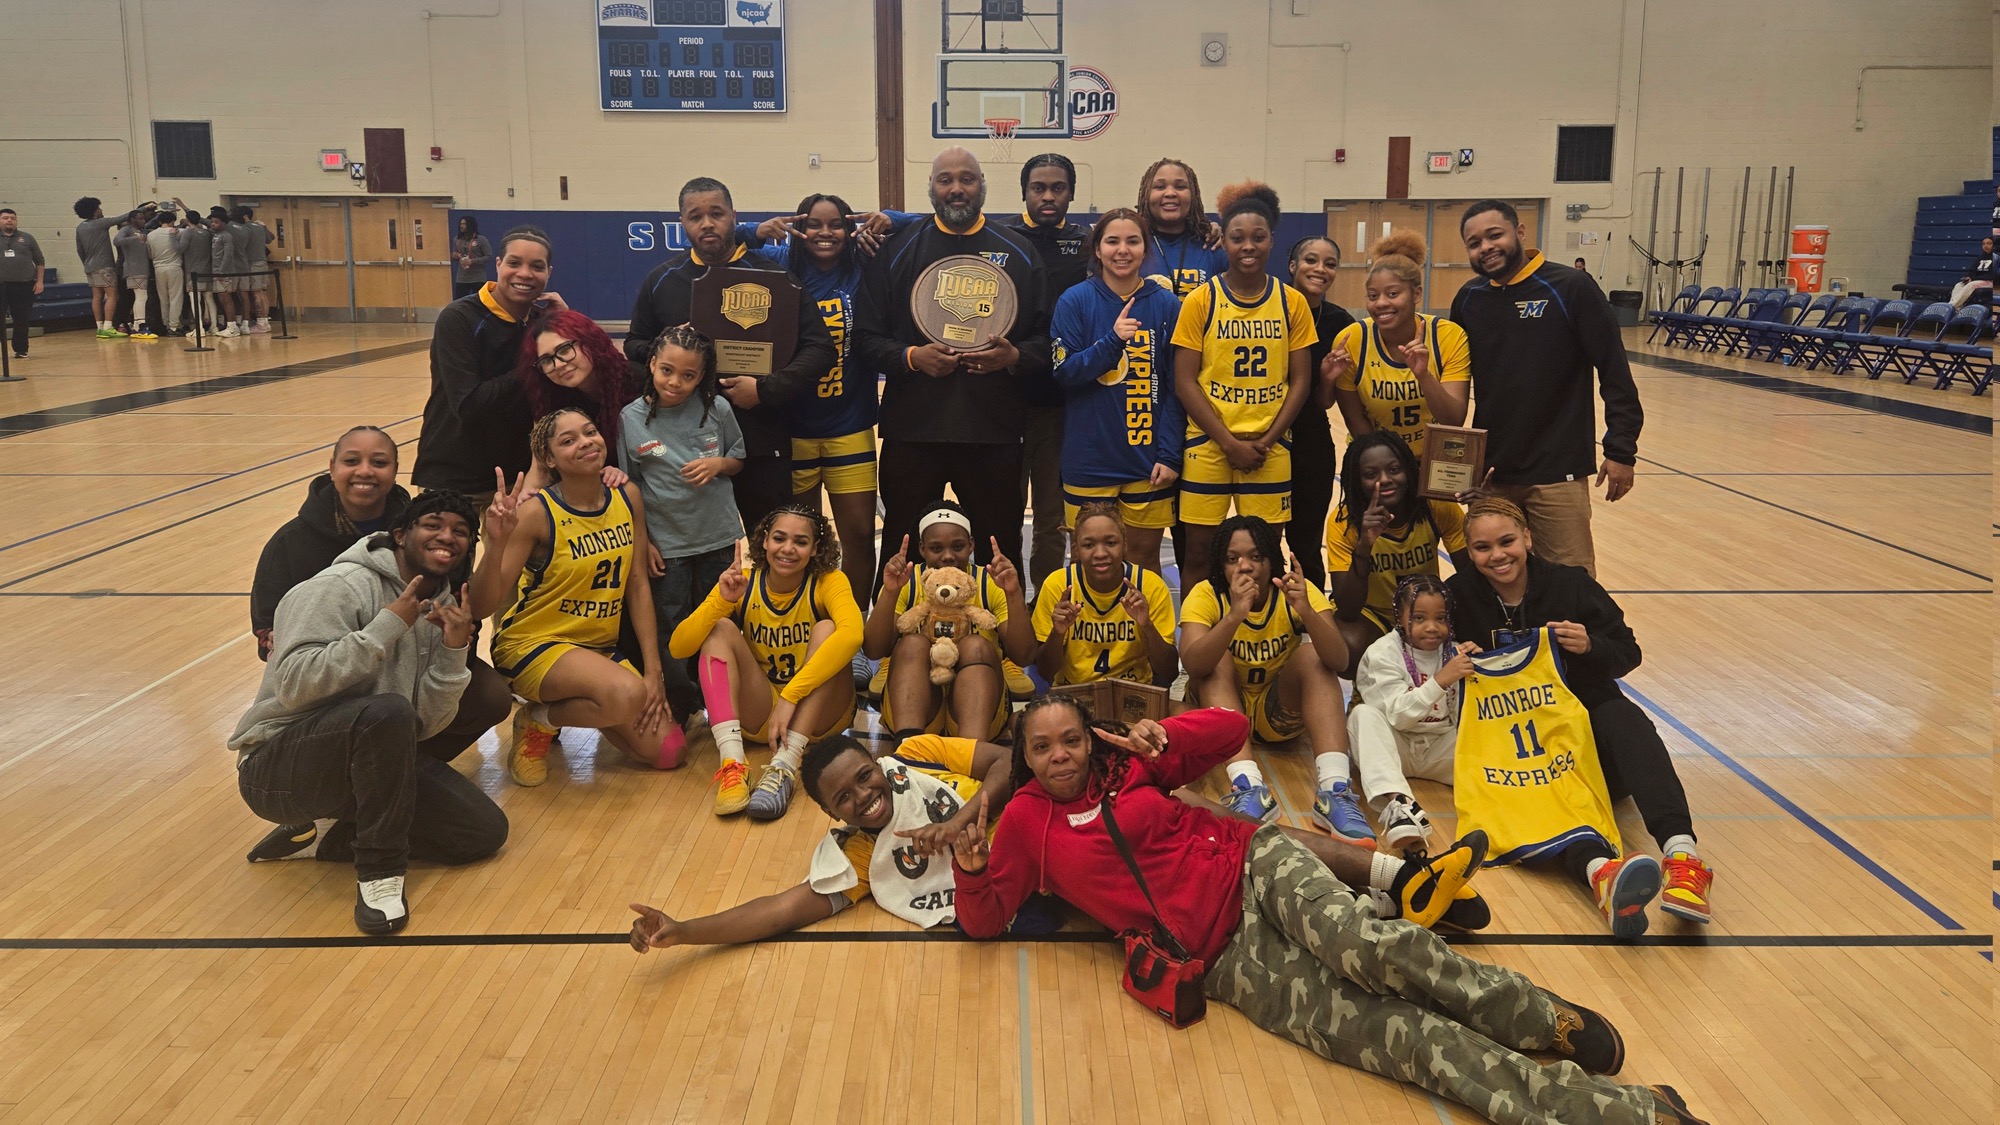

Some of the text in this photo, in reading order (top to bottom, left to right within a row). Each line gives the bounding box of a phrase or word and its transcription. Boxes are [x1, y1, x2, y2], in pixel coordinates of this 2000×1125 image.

[602, 8, 648, 20] SHARKS
[741, 9, 764, 18] njcaa
[678, 37, 704, 45] PERIOD
[609, 69, 632, 77] FOULS
[640, 69, 661, 78] T.O.L.
[668, 69, 717, 78] PLAYER FOUL
[724, 70, 745, 78] T.O.L.
[752, 70, 775, 78] FOULS
[610, 100, 633, 108] SCORE
[681, 100, 705, 108] MATCH
[753, 101, 776, 109] SCORE
[1434, 156, 1449, 167] EXIT
[1807, 264, 1818, 275] G
[937, 272, 997, 298] NJCAA
[723, 289, 770, 311] NJCAA
[978, 303, 991, 313] 15
[1518, 299, 1549, 318] M
[1216, 319, 1283, 340] MONROE
[1233, 345, 1268, 378] 22
[1209, 380, 1284, 405] EXPRESS
[1371, 379, 1425, 401] MONR
[1391, 404, 1421, 427] 15
[567, 522, 633, 560] MONROE
[1370, 543, 1435, 573] MONROE
[590, 556, 622, 590] 21
[558, 597, 623, 618] EXPRE
[750, 621, 811, 648] MONROE
[1071, 620, 1136, 643] MONROE
[1228, 633, 1289, 662] MONROE
[767, 652, 796, 679] 13
[1093, 649, 1111, 675] 4
[1248, 667, 1266, 684] 0
[1475, 683, 1557, 721] MONROE
[1509, 719, 1546, 760] 11
[1483, 750, 1577, 787] EXPRESS
